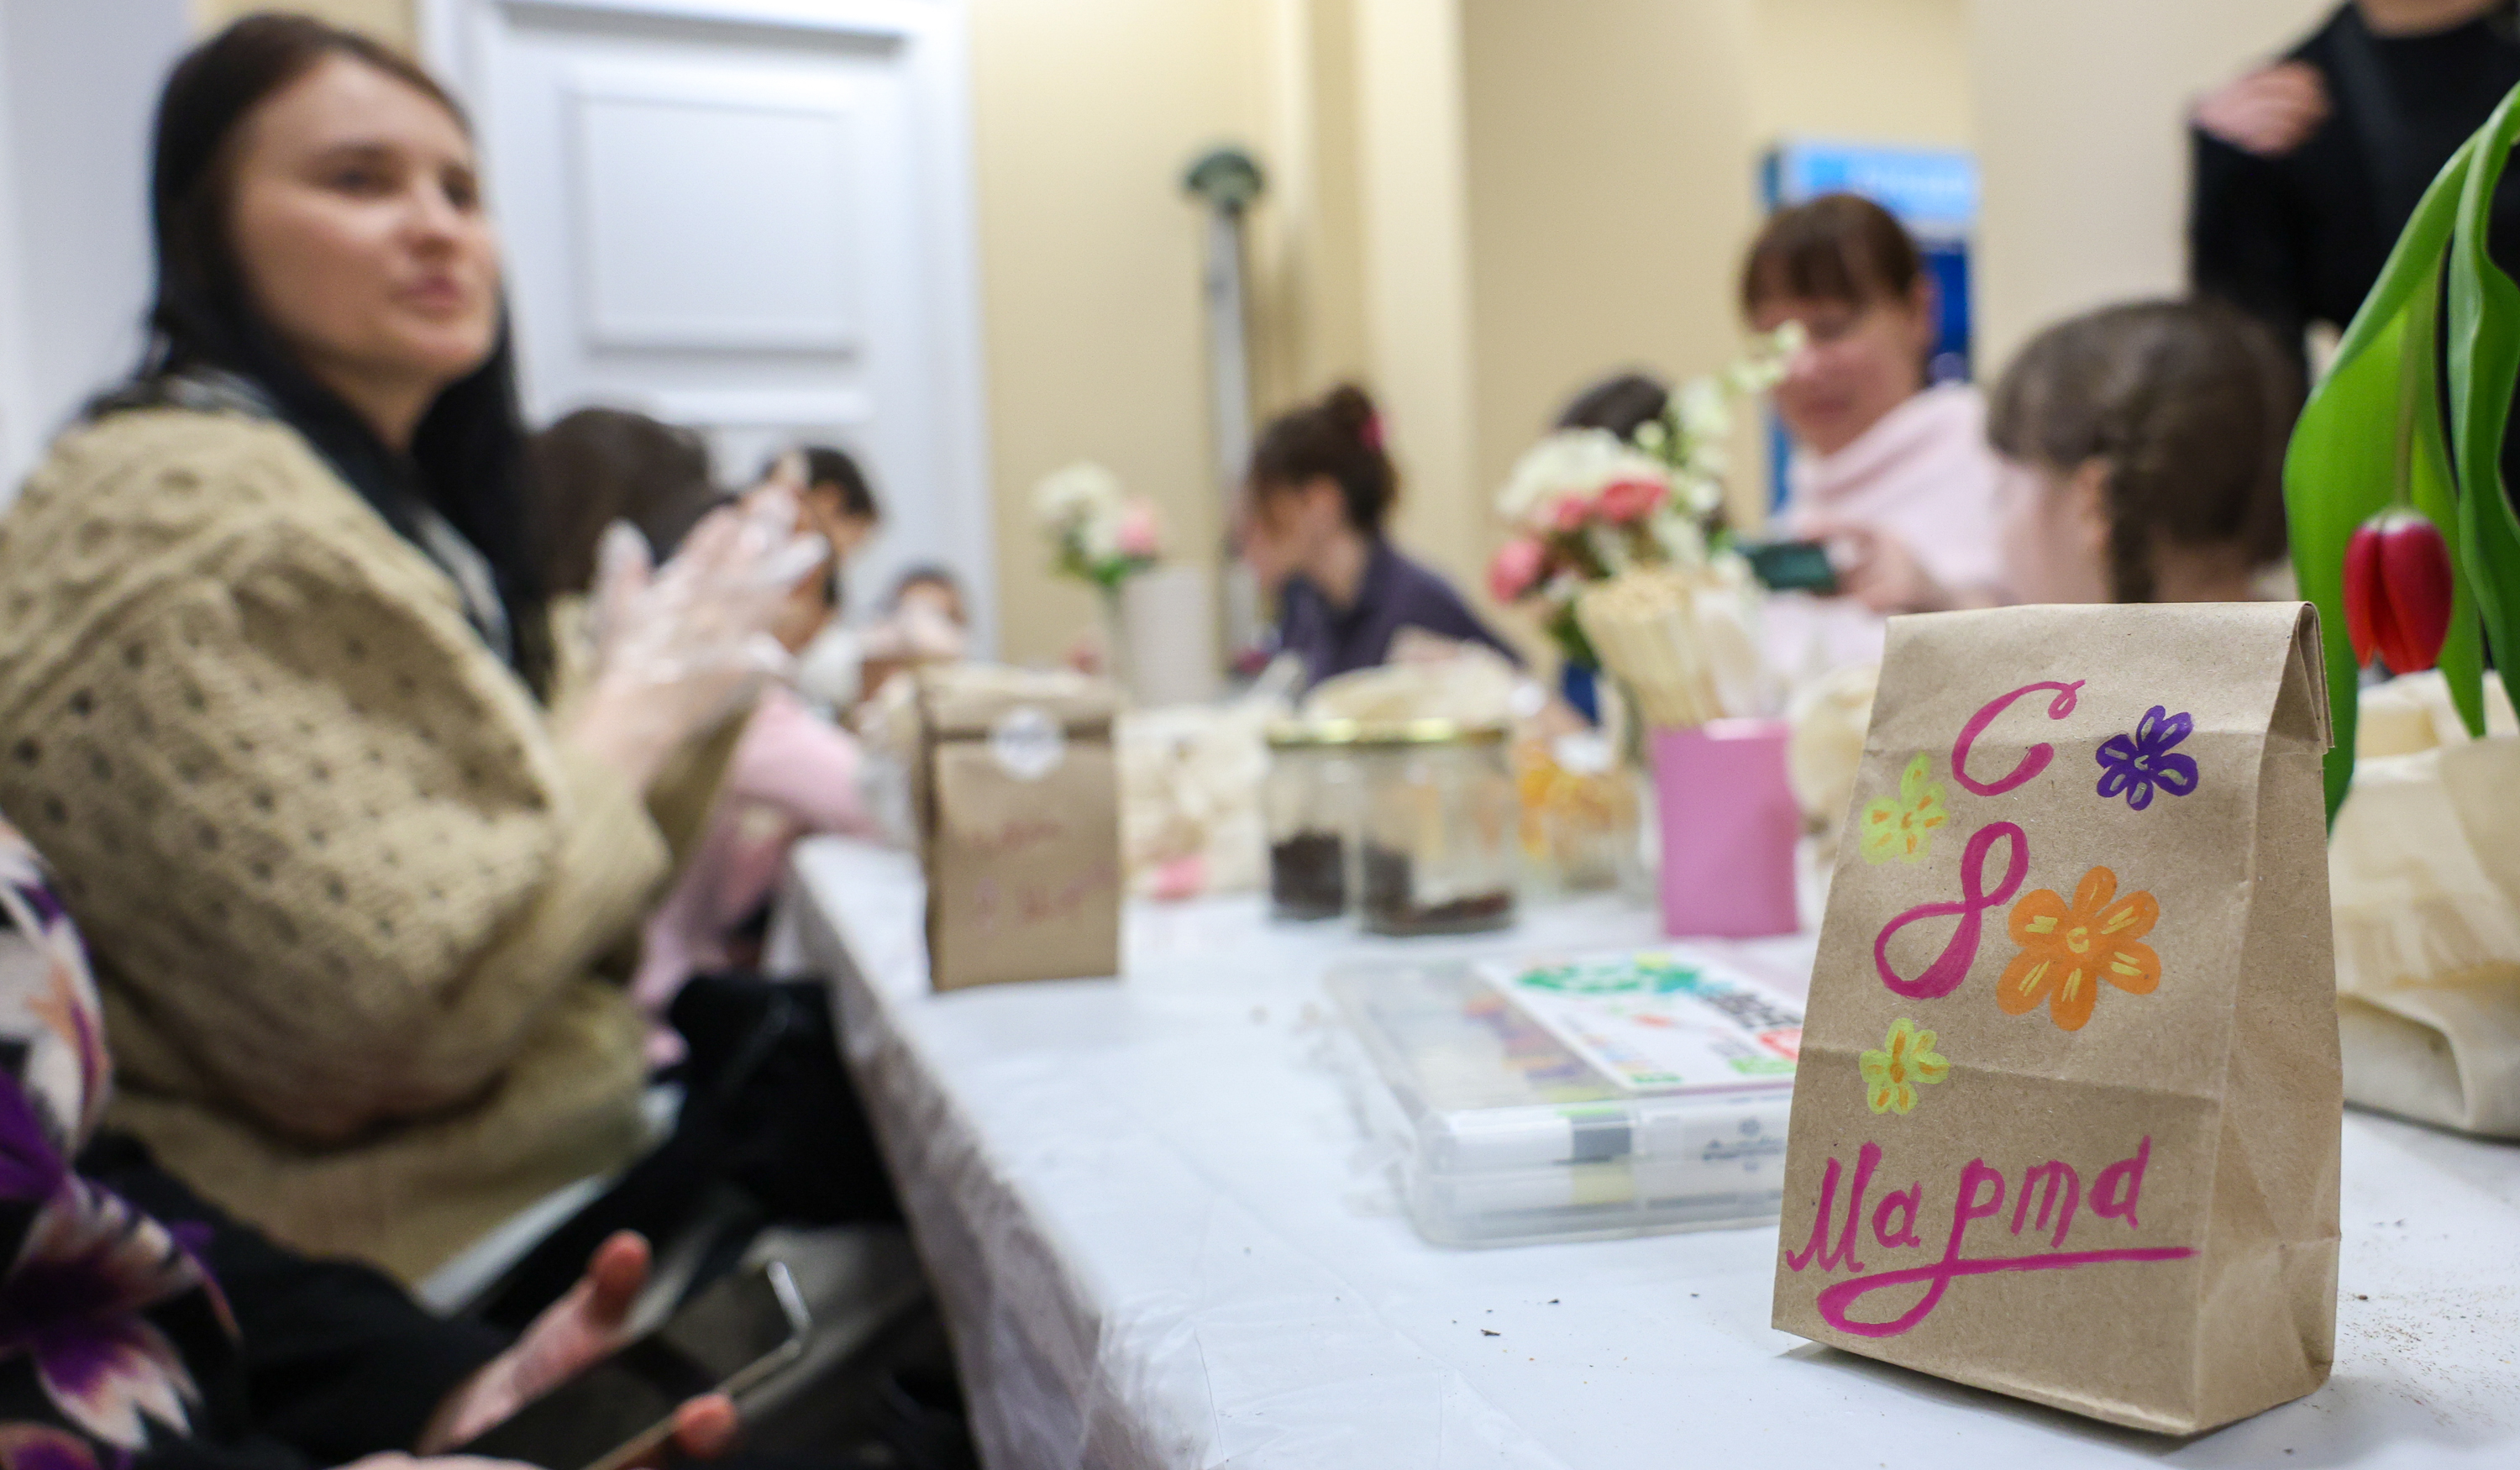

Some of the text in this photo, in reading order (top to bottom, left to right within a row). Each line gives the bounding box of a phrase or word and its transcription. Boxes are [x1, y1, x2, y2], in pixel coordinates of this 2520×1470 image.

[1950, 678, 2087, 797] С
[1874, 821, 2029, 1000] 8
[1786, 1136, 2196, 1338] Марта
